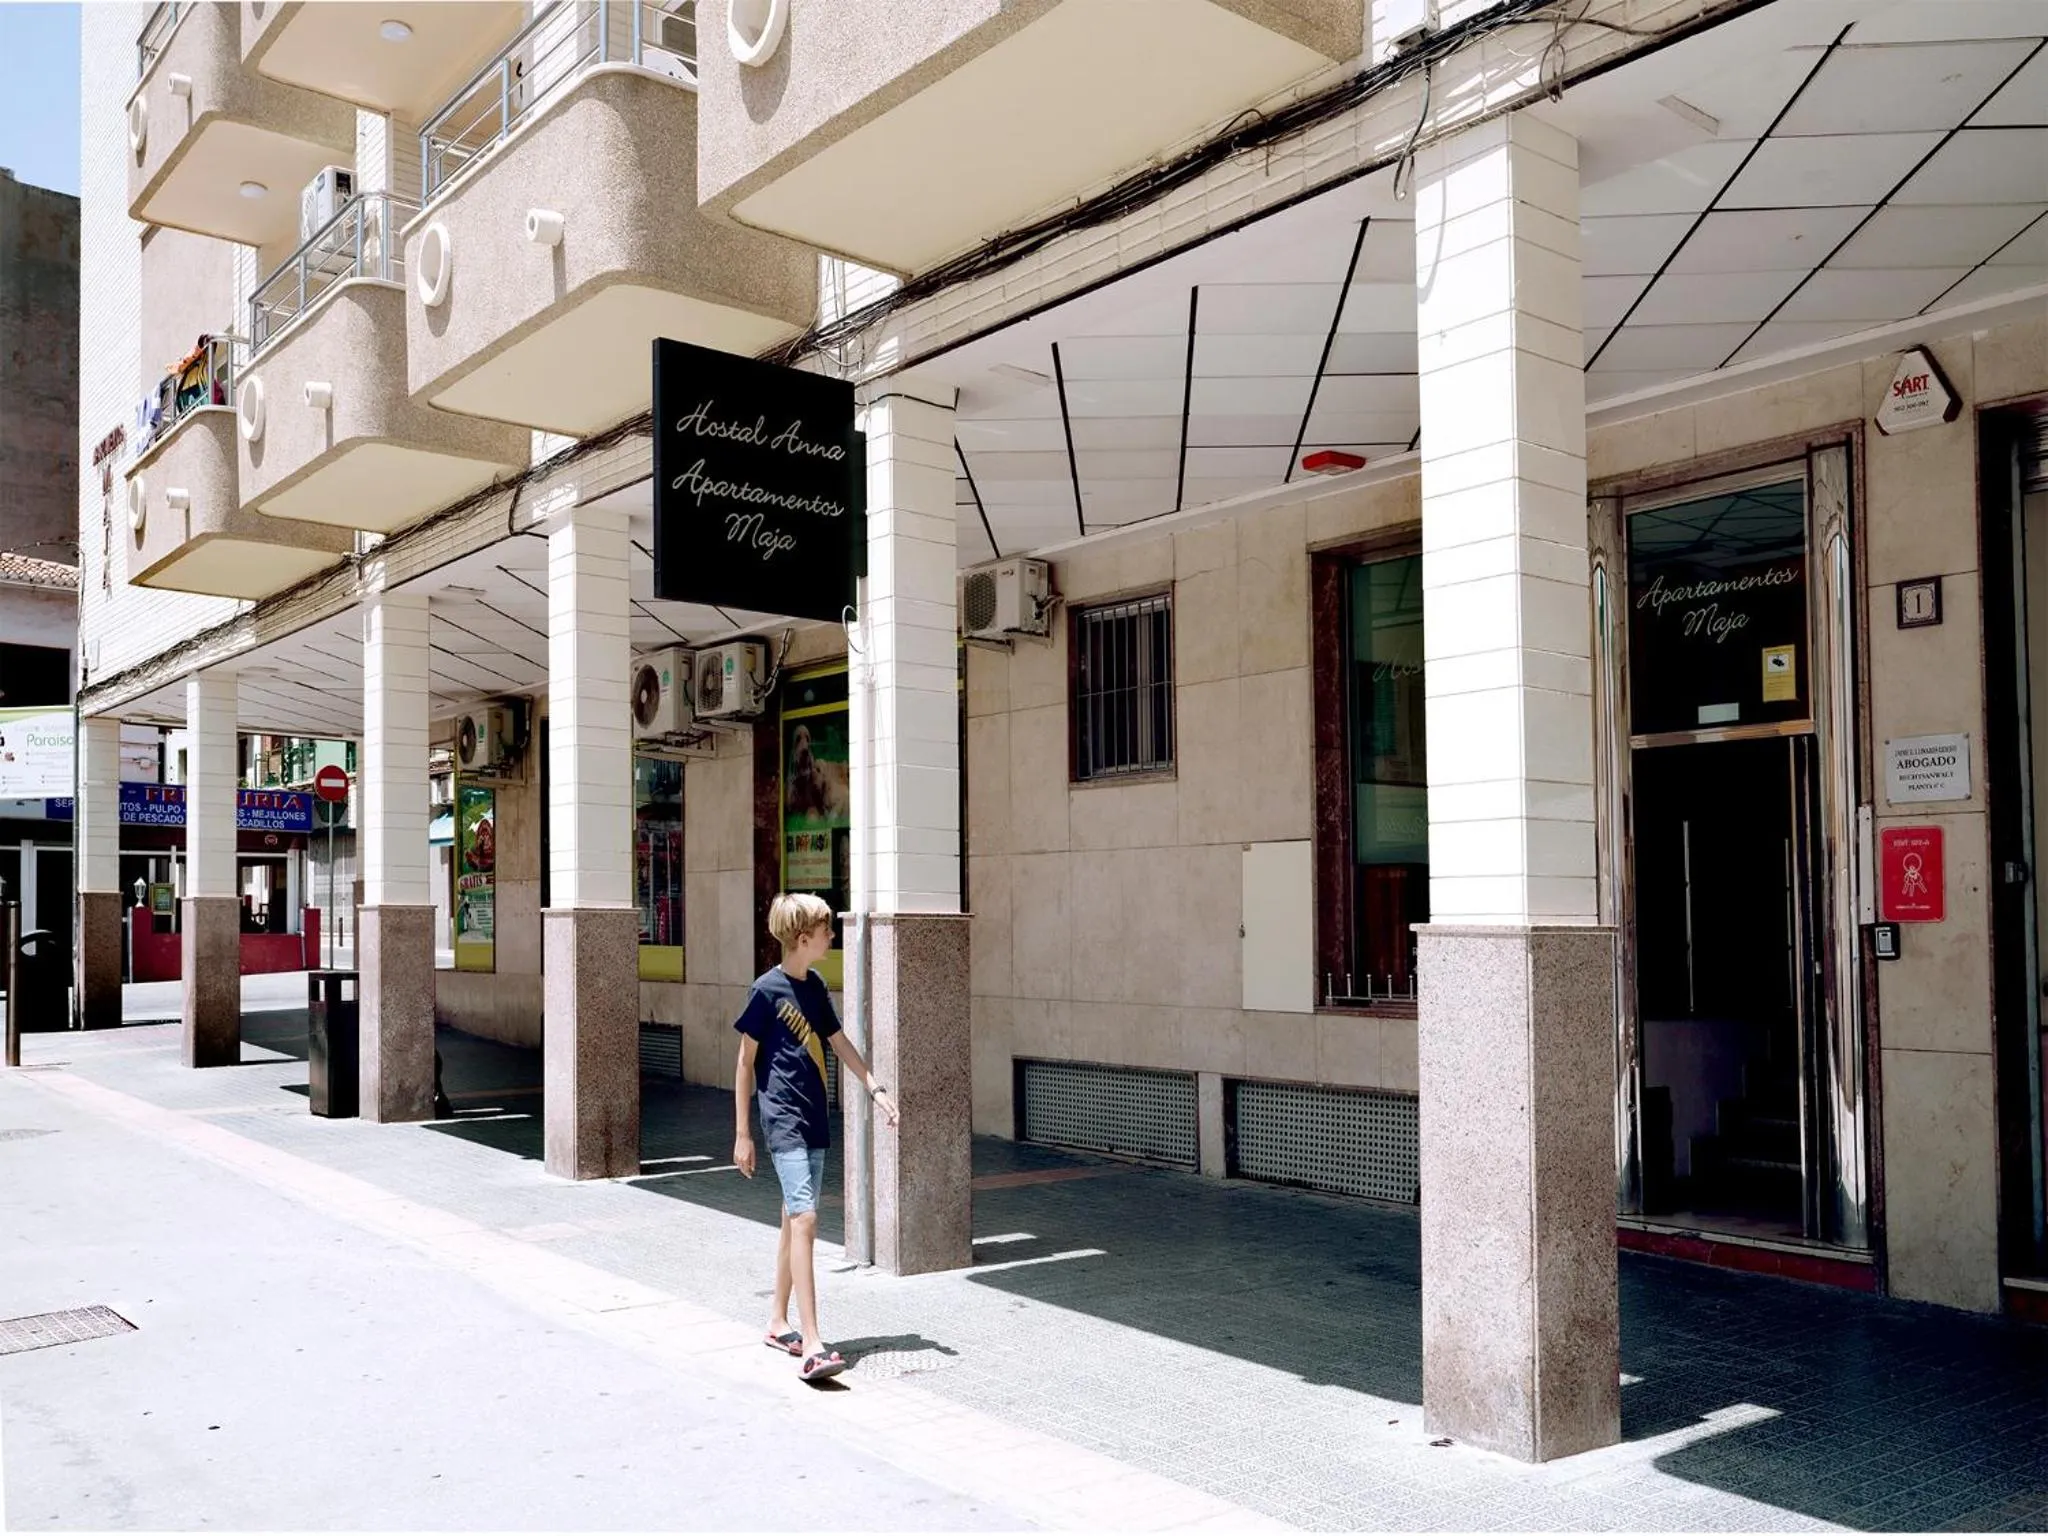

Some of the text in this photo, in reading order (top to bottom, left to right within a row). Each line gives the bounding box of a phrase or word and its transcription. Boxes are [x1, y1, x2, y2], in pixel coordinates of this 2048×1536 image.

[676, 399, 846, 462] Hostal Anna
[672, 458, 845, 518] Apartamentos
[724, 512, 797, 560] Maja
[1636, 567, 1799, 616] Apartamentos
[1682, 602, 1750, 644] Maja
[1897, 756, 1956, 770] ABOGADO
[123, 812, 136, 822] DE
[139, 812, 184, 824] PESCADO
[149, 803, 181, 814] PULPO
[251, 808, 307, 821] MEJILLONES
